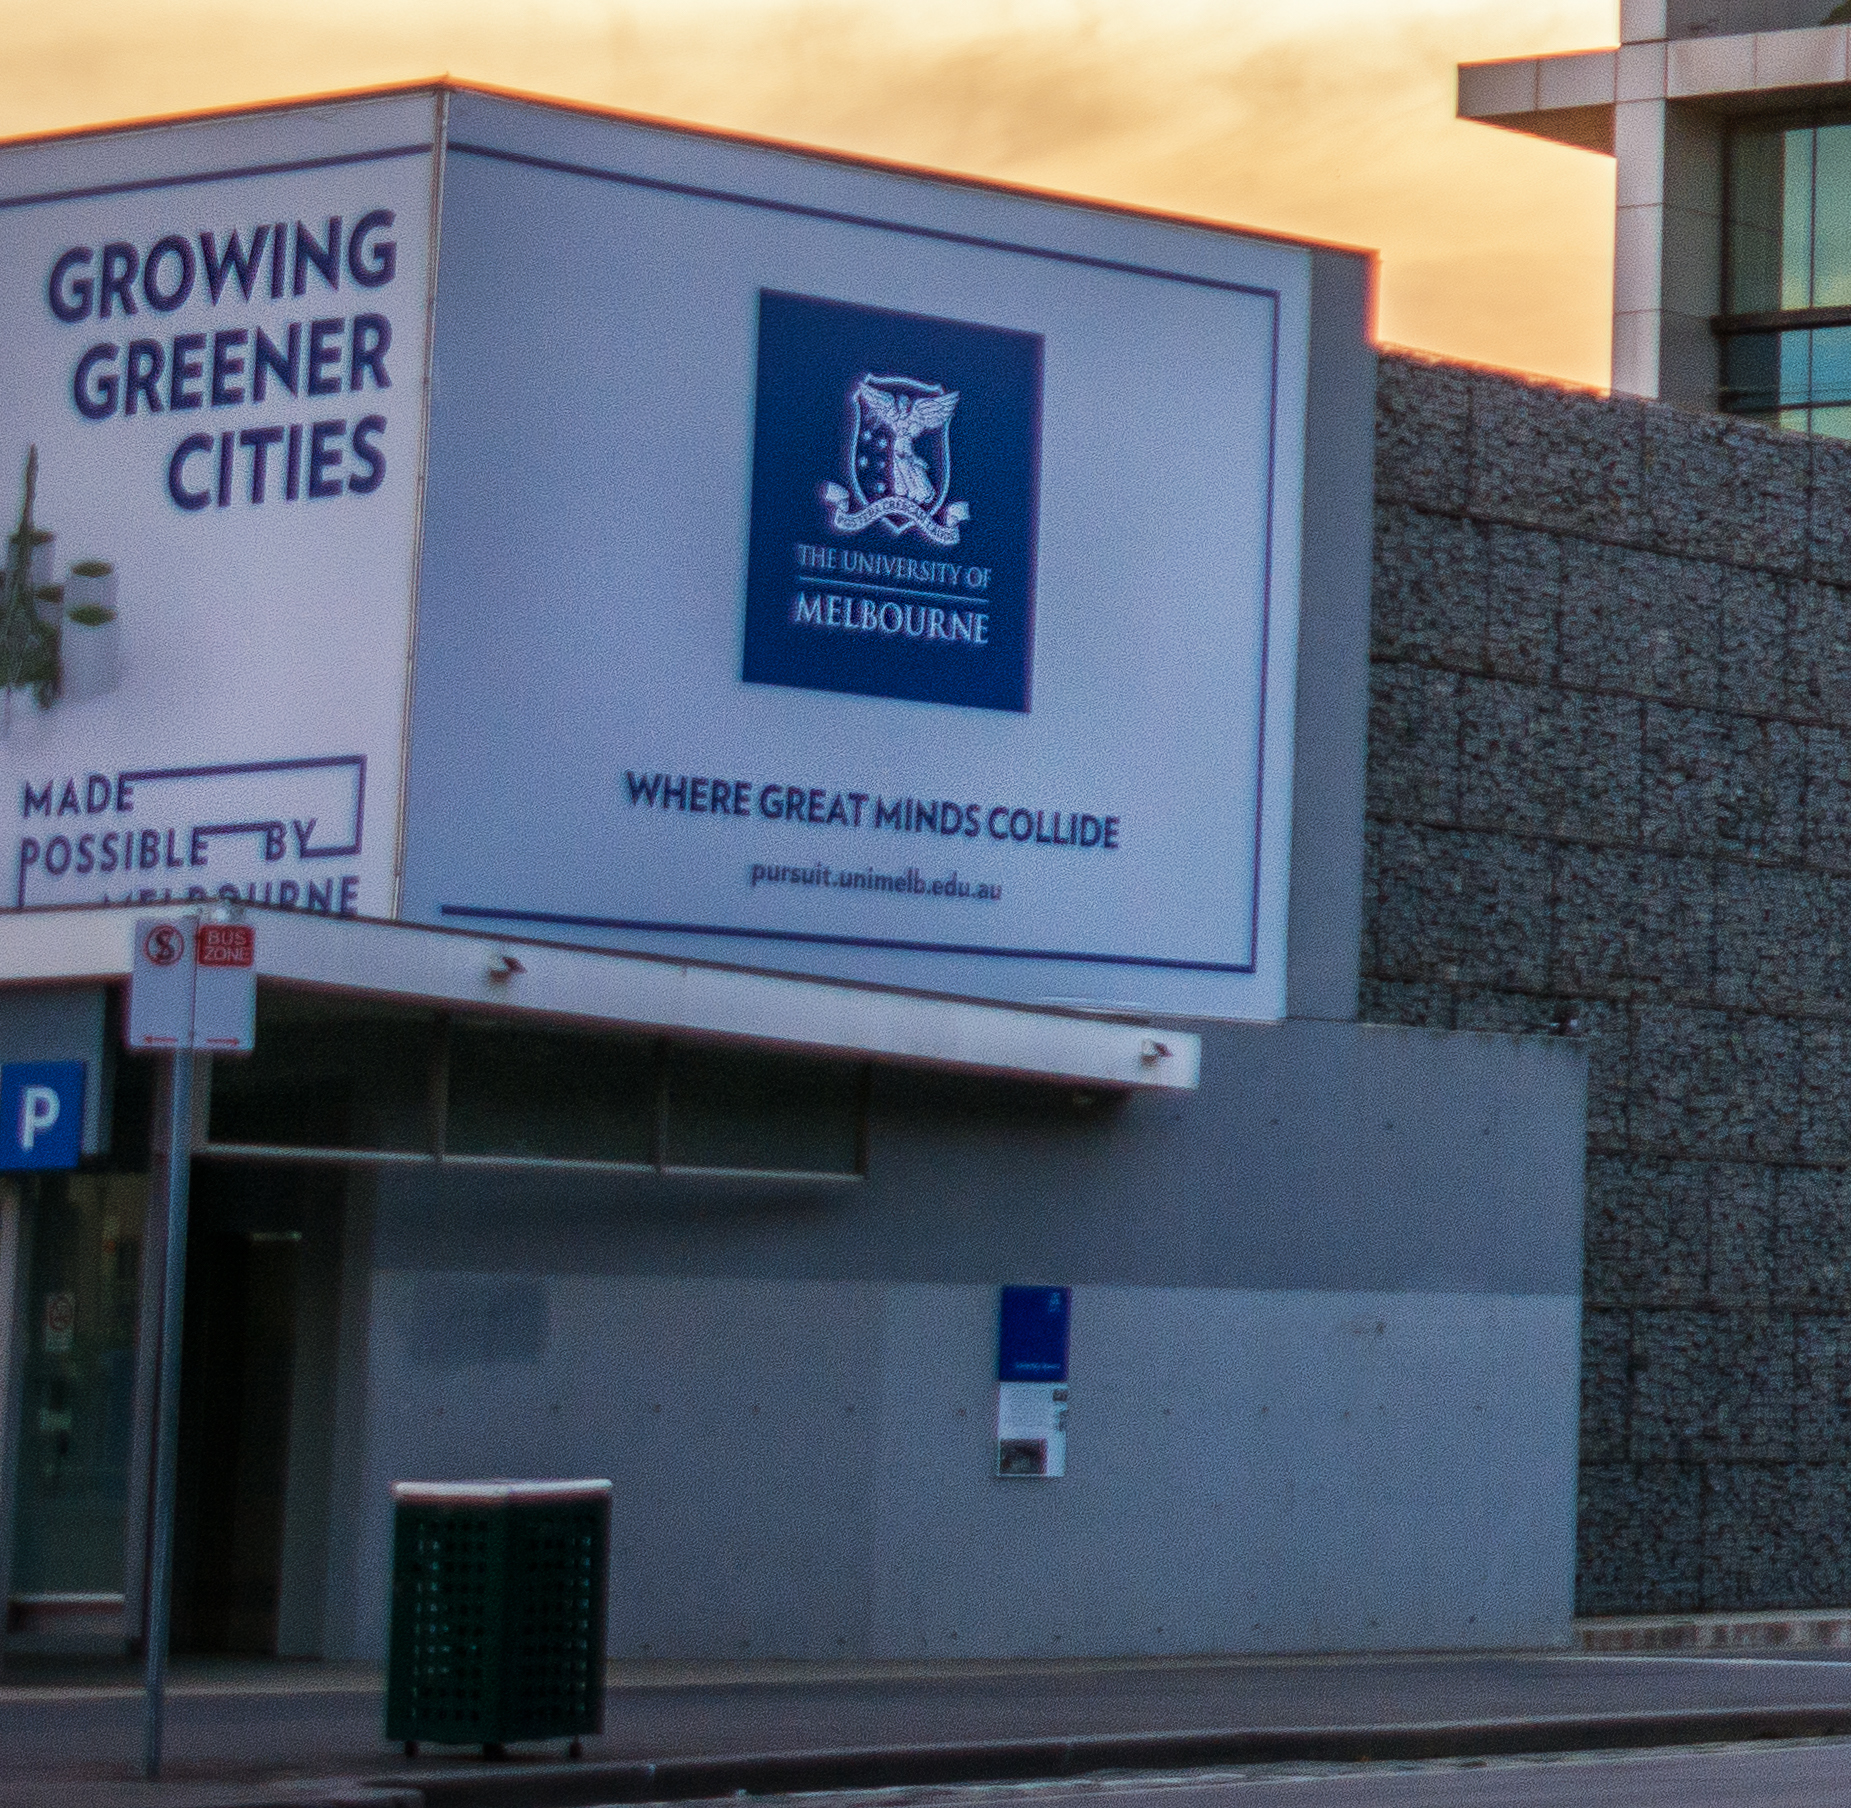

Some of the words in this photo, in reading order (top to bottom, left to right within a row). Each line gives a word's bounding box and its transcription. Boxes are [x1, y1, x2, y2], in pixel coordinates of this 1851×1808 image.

[49, 208, 398, 325] GROWING
[73, 313, 392, 420] GREENER
[167, 415, 387, 511] CITIES
[797, 543, 837, 572] THE
[842, 549, 961, 586] UNIVERSITY
[965, 565, 992, 589] OF
[795, 592, 990, 645] MELBOURNE
[23, 773, 134, 818] MADE
[625, 770, 753, 817] WHERE
[759, 784, 869, 825] GREAT
[876, 796, 981, 838] MINDS
[990, 805, 1121, 849] COLLIDE
[20, 826, 209, 876] POSSIBLE
[263, 818, 317, 862] BY
[751, 861, 1002, 902] pursuit.unimelb.edu.au
[204, 946, 250, 961] ZONE
[207, 930, 247, 945] BUS
[20, 1085, 60, 1152] P
